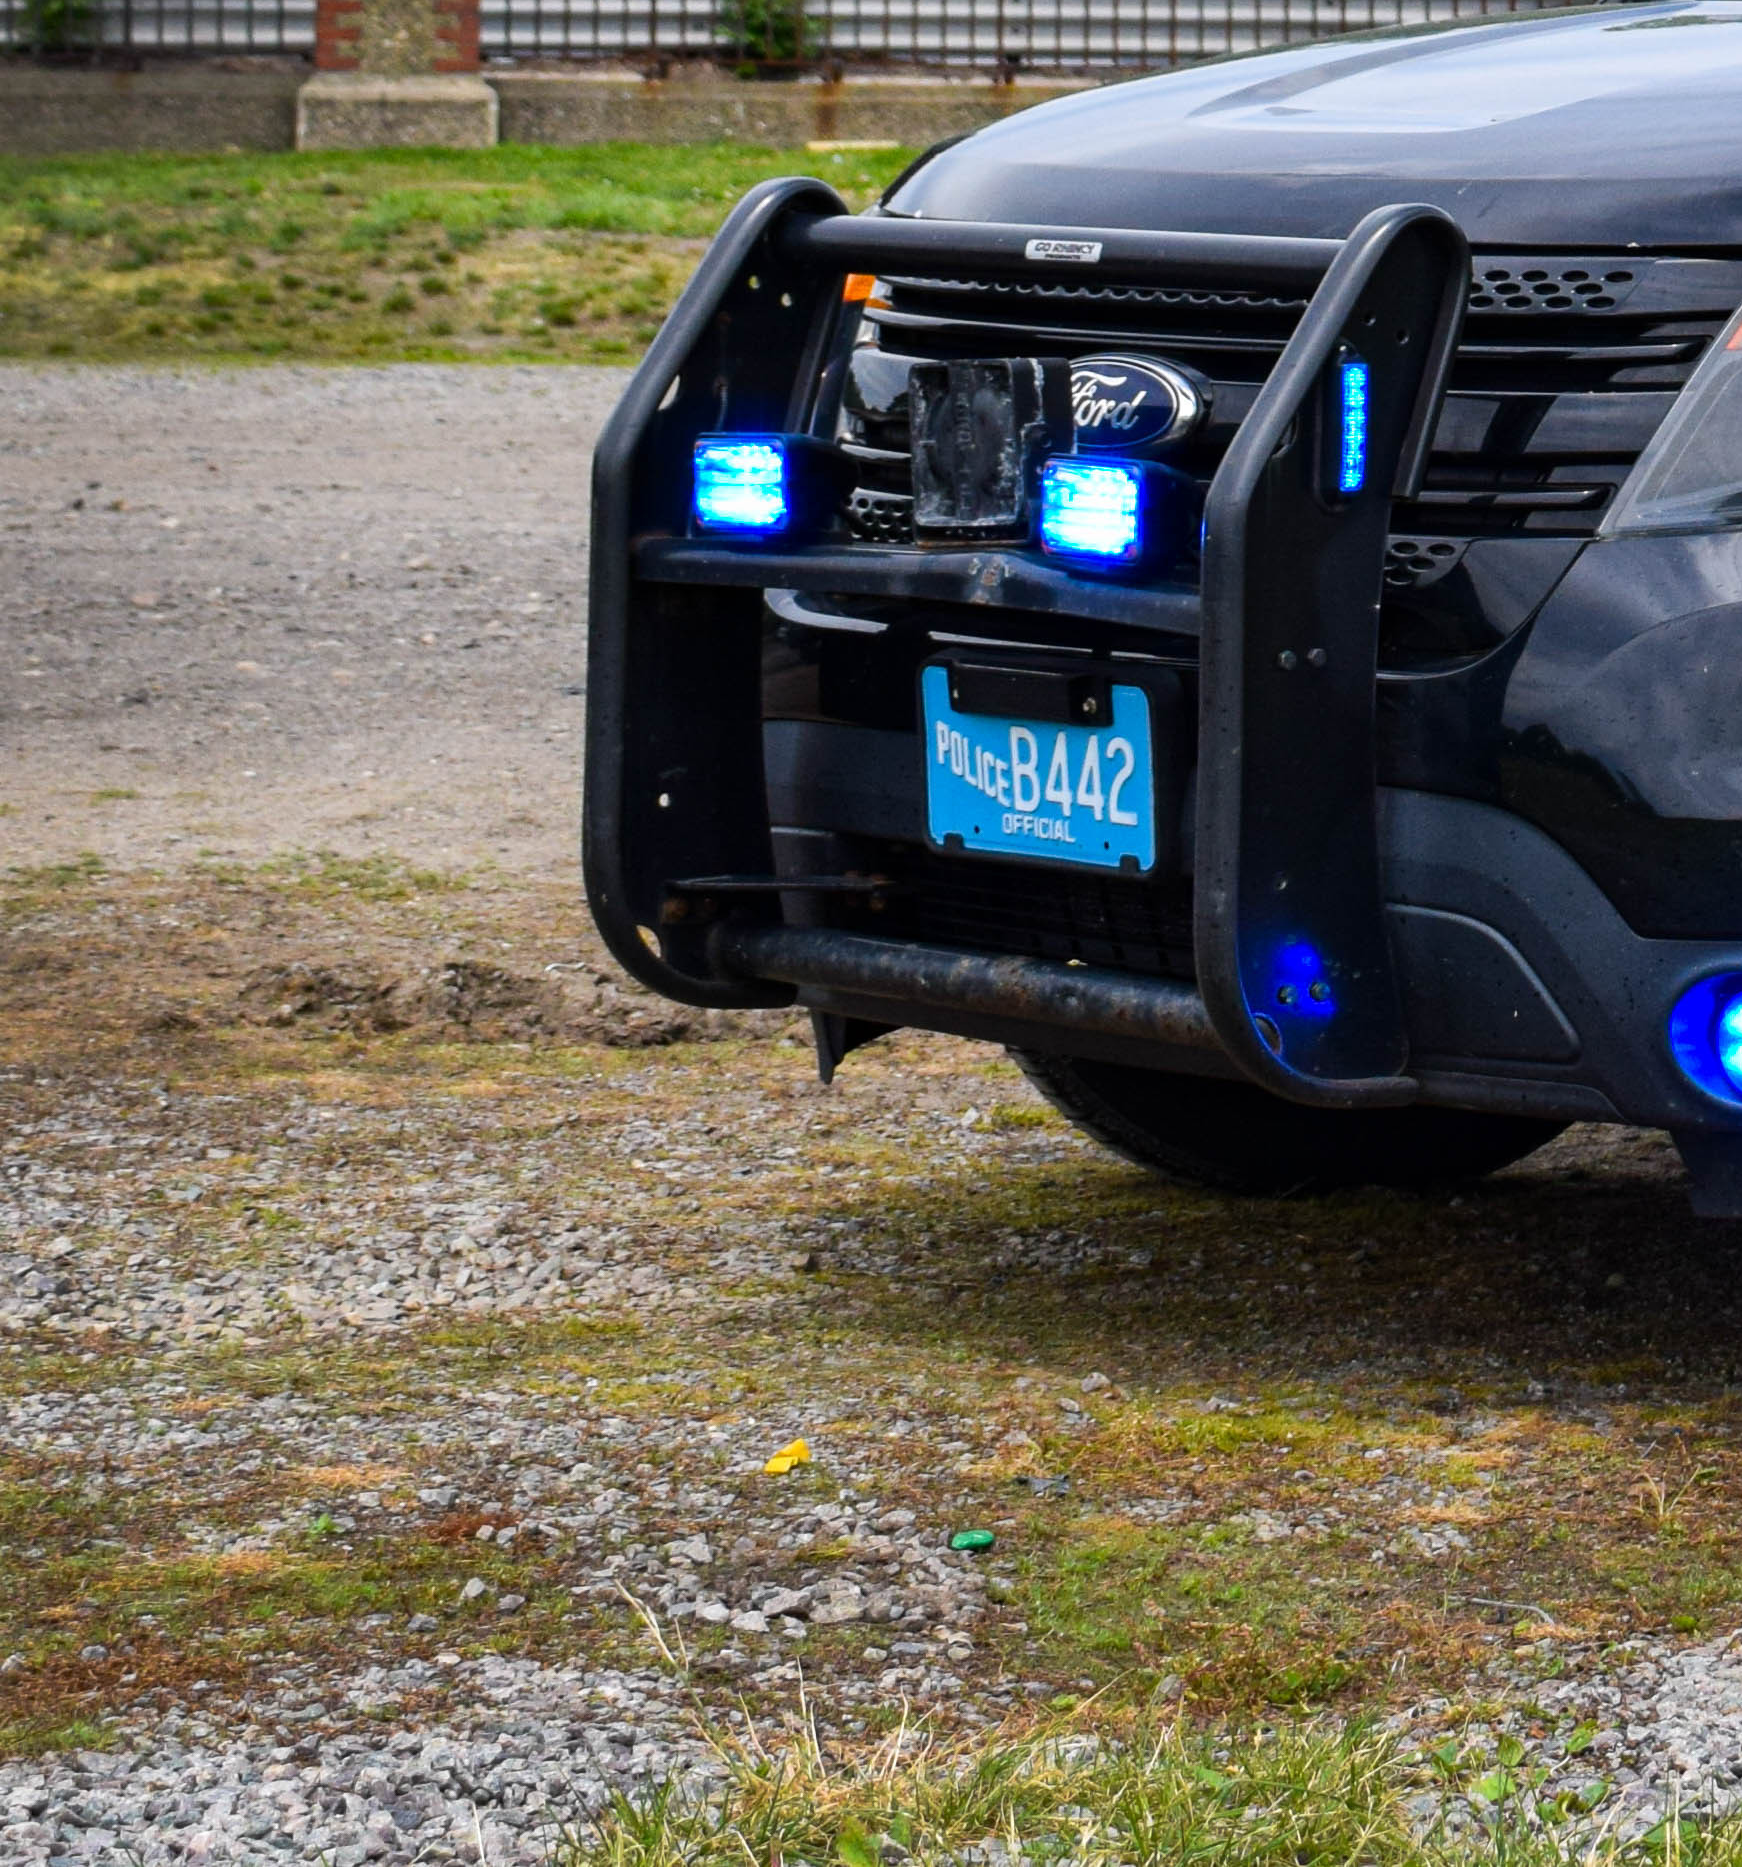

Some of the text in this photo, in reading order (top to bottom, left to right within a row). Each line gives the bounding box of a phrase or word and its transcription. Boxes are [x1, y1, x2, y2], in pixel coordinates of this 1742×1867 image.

[1070, 370, 1147, 430] Ford
[935, 719, 1138, 826] POLICE B442
[1002, 813, 1077, 843] OFFICIAL
